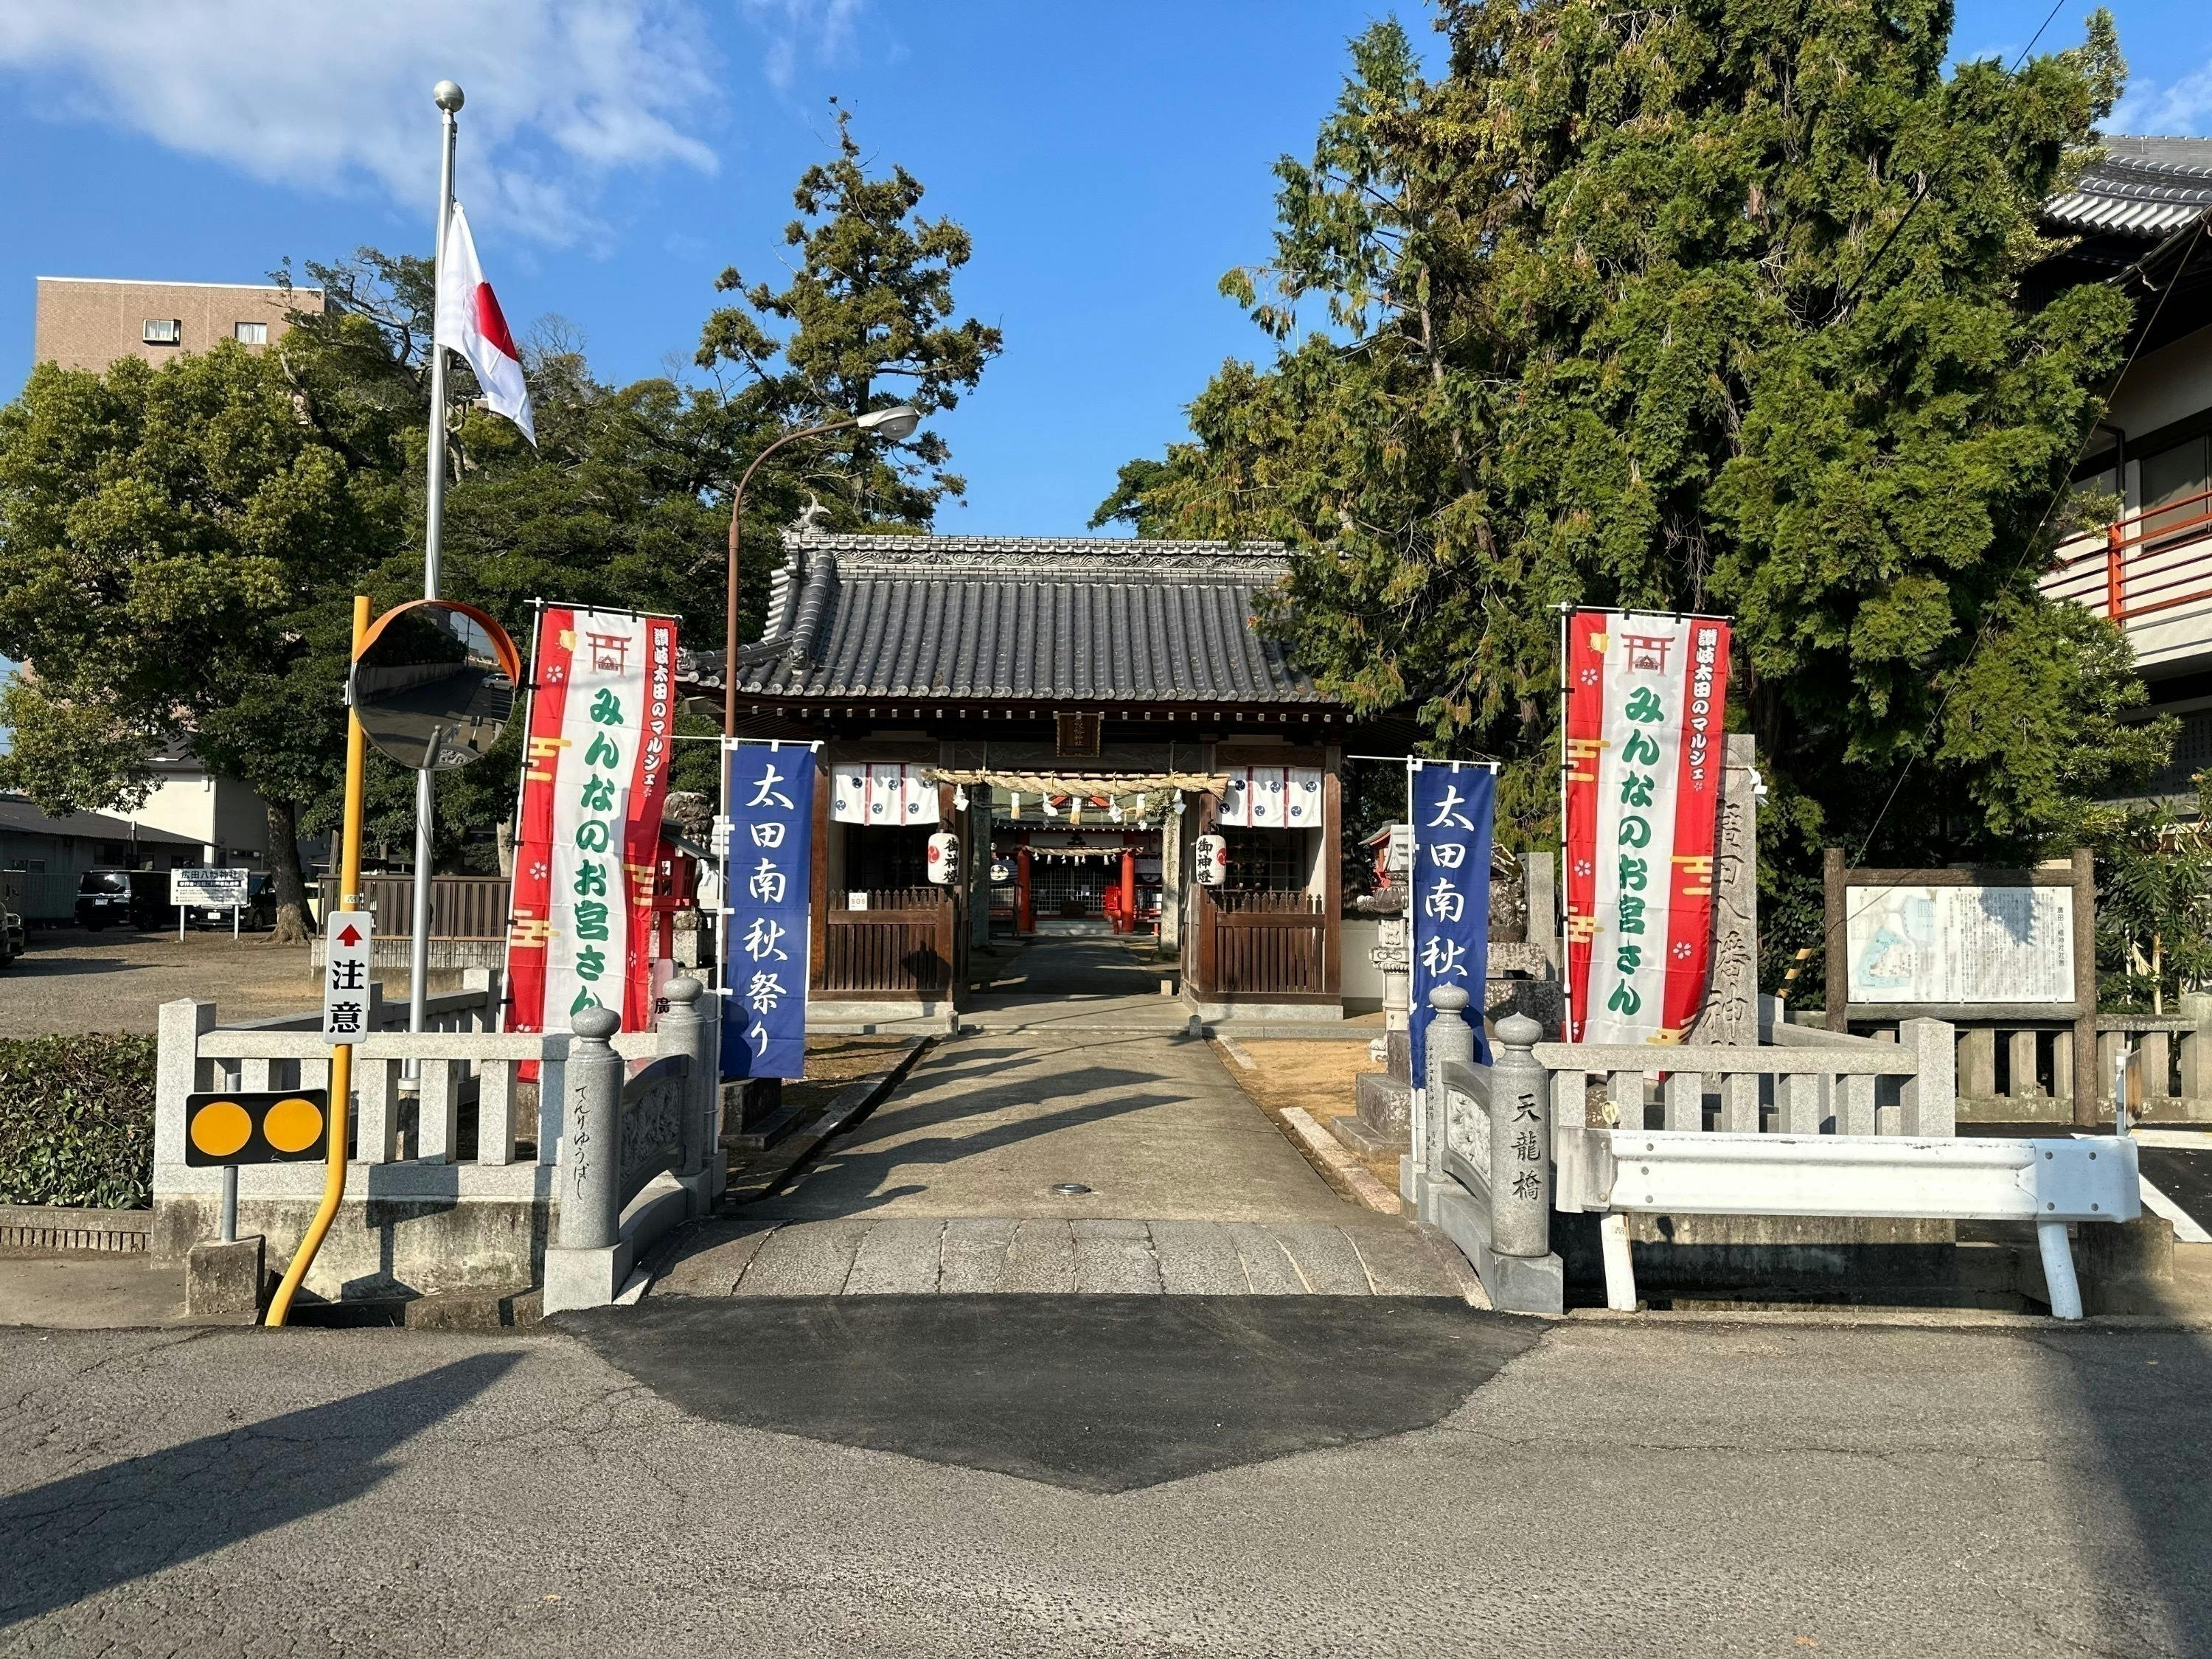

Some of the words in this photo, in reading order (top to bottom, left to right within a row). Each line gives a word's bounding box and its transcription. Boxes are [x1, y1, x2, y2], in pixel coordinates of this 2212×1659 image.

[643, 627, 669, 785] 讃岐太田のマルシェ
[1688, 627, 1718, 780] 讃岐太田のマルシェ
[181, 870, 238, 880] 広田八幡神社
[568, 686, 625, 1018] みんなのお宮さん
[742, 764, 794, 1058] 太田南秋祭り
[942, 837, 959, 883] 御神燈
[1197, 837, 1214, 883] 御神燈
[1419, 785, 1474, 1010] 太田南秋
[1607, 686, 1665, 1015] みんなのお宮さん
[329, 959, 365, 1034] 注意
[574, 1085, 591, 1200] てんりゆうばし
[1511, 1093, 1543, 1201] 天龍橋
